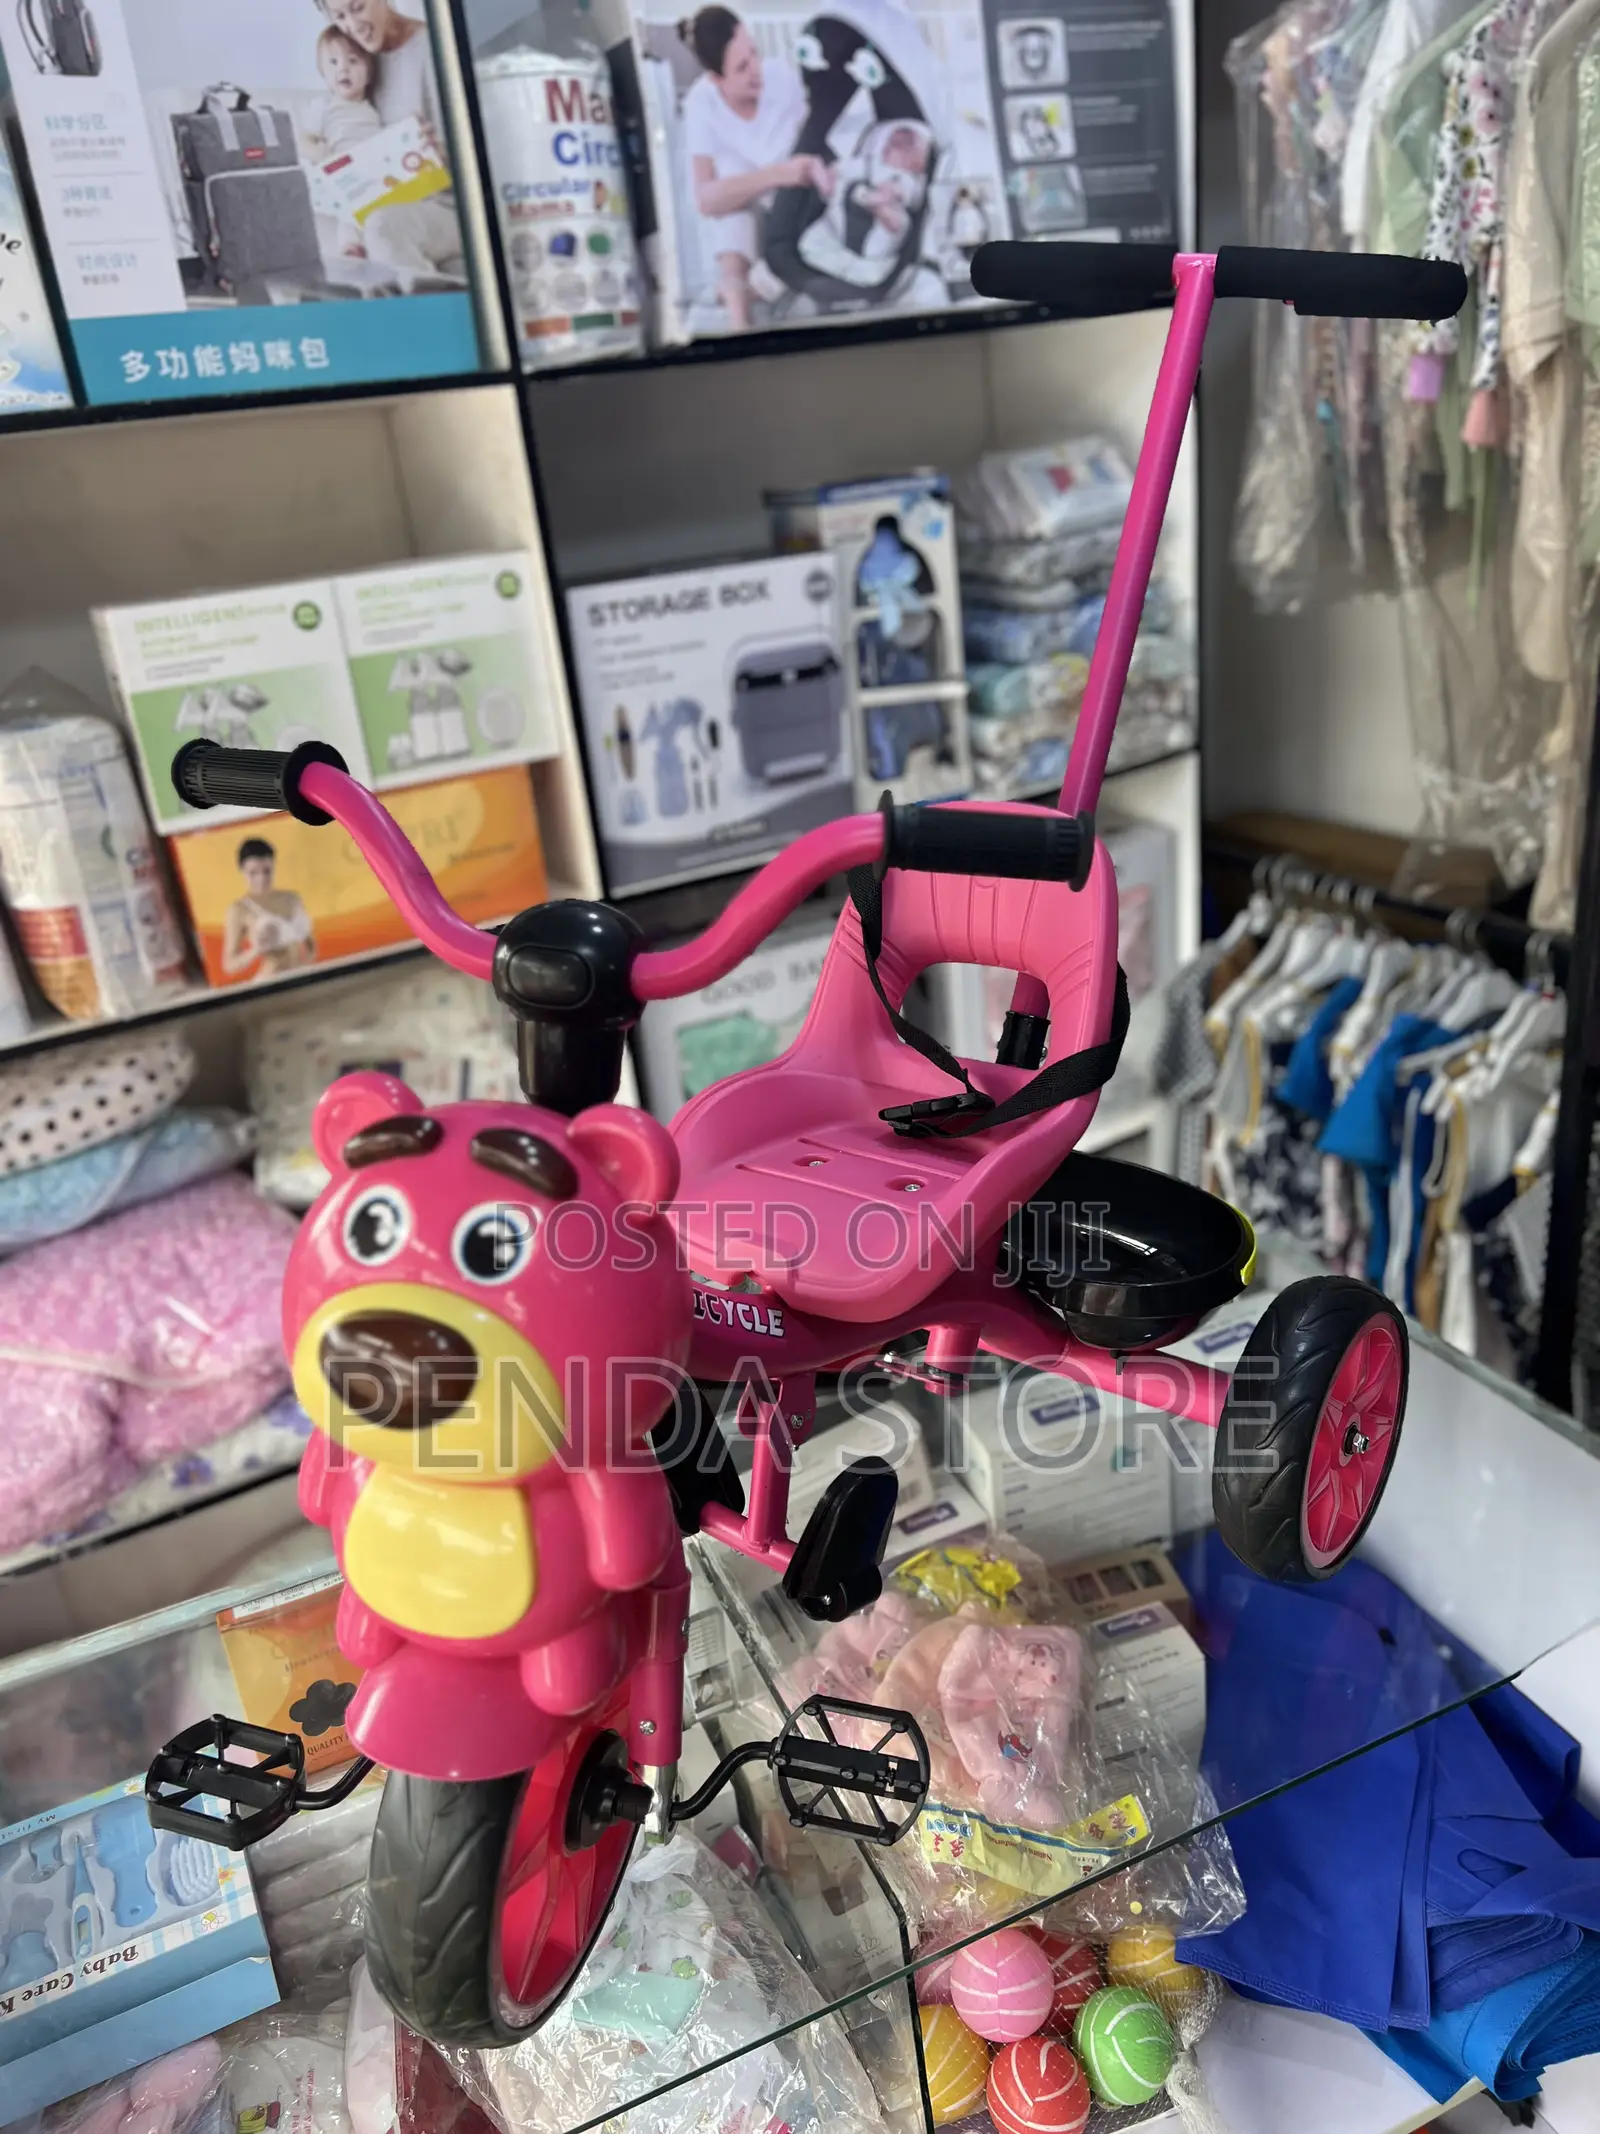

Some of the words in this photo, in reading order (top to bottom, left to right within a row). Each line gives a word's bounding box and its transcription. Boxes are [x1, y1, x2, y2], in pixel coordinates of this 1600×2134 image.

[544, 79, 613, 124] Ma
[552, 131, 622, 168] Circ
[120, 337, 330, 384] 多功能妈咪包
[588, 587, 709, 626] STORAGE
[719, 580, 770, 607] BOX
[692, 1287, 785, 1338] ICYCLE
[307, 1733, 345, 1756] QUALITY
[80, 1944, 139, 1978] Baby
[21, 1972, 75, 2002] Care
[0, 1996, 16, 2017] K
